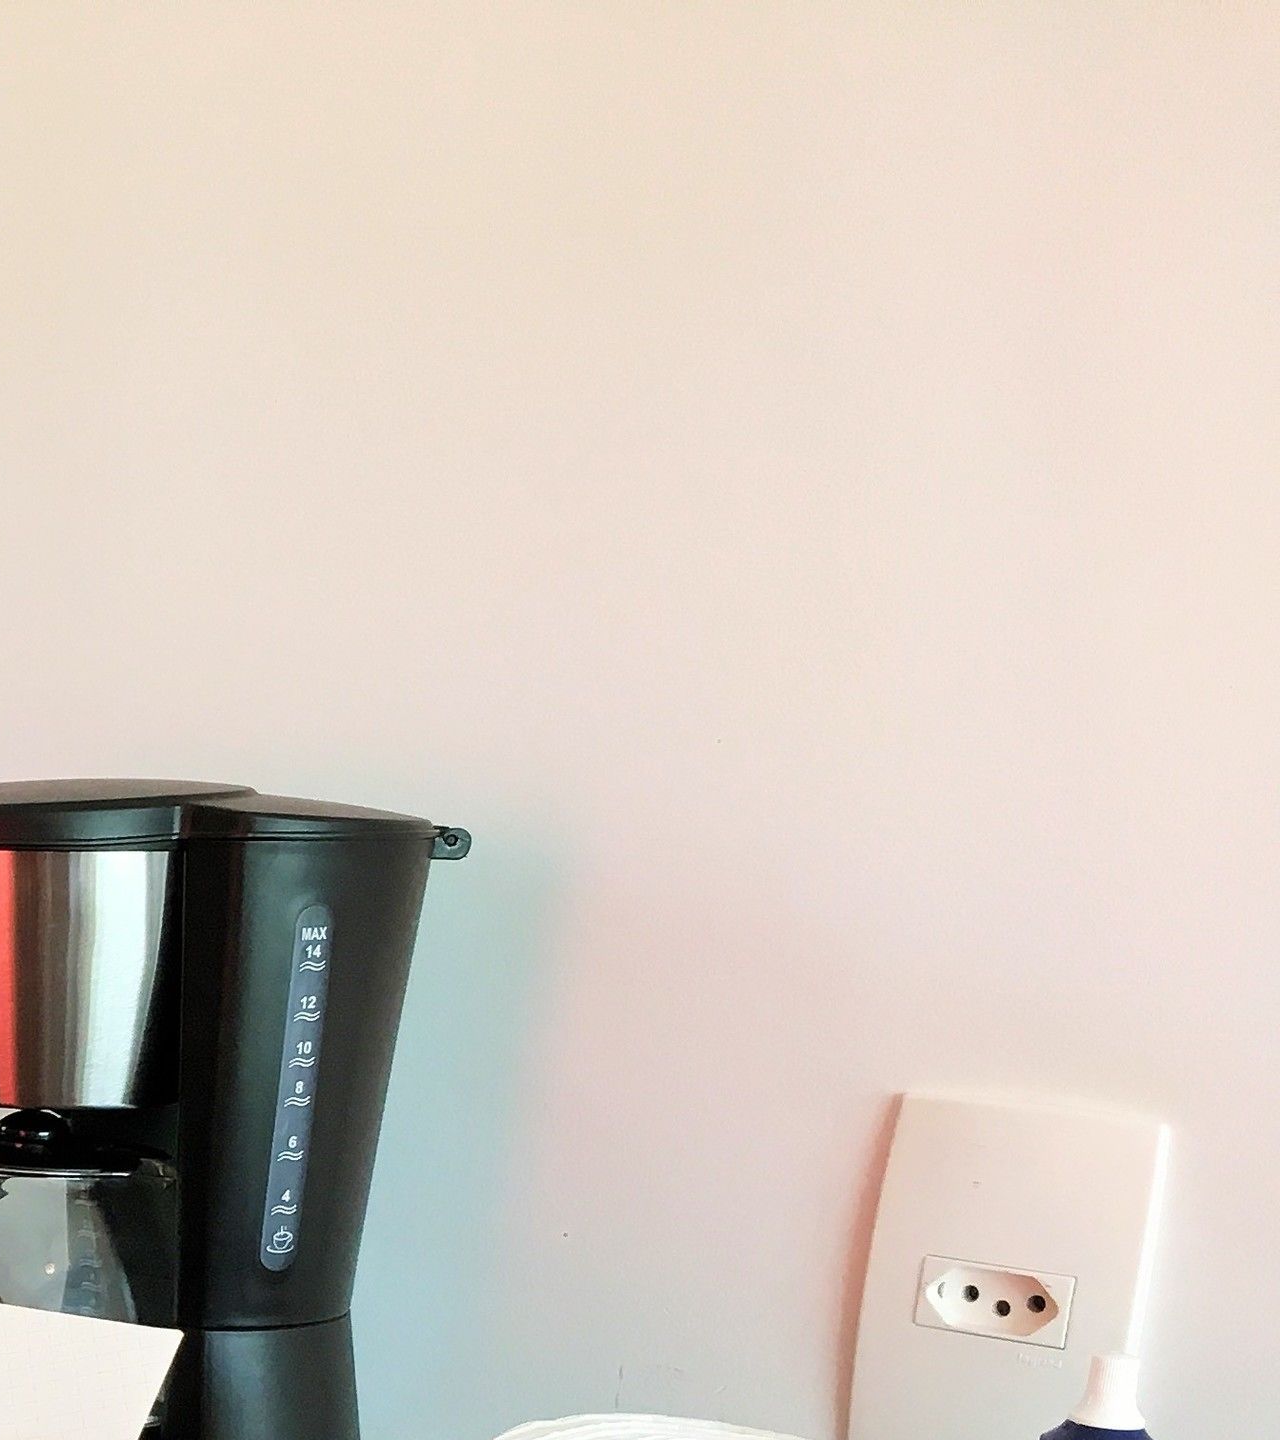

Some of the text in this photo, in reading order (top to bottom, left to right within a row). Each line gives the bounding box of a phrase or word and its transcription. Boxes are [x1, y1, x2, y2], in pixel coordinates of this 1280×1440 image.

[301, 926, 328, 941] MAX
[306, 945, 322, 959] 14
[300, 996, 317, 1010] 12
[296, 1041, 313, 1055] 10
[295, 1081, 304, 1095] 8
[288, 1135, 297, 1149] 6
[281, 1189, 291, 1203] 4
